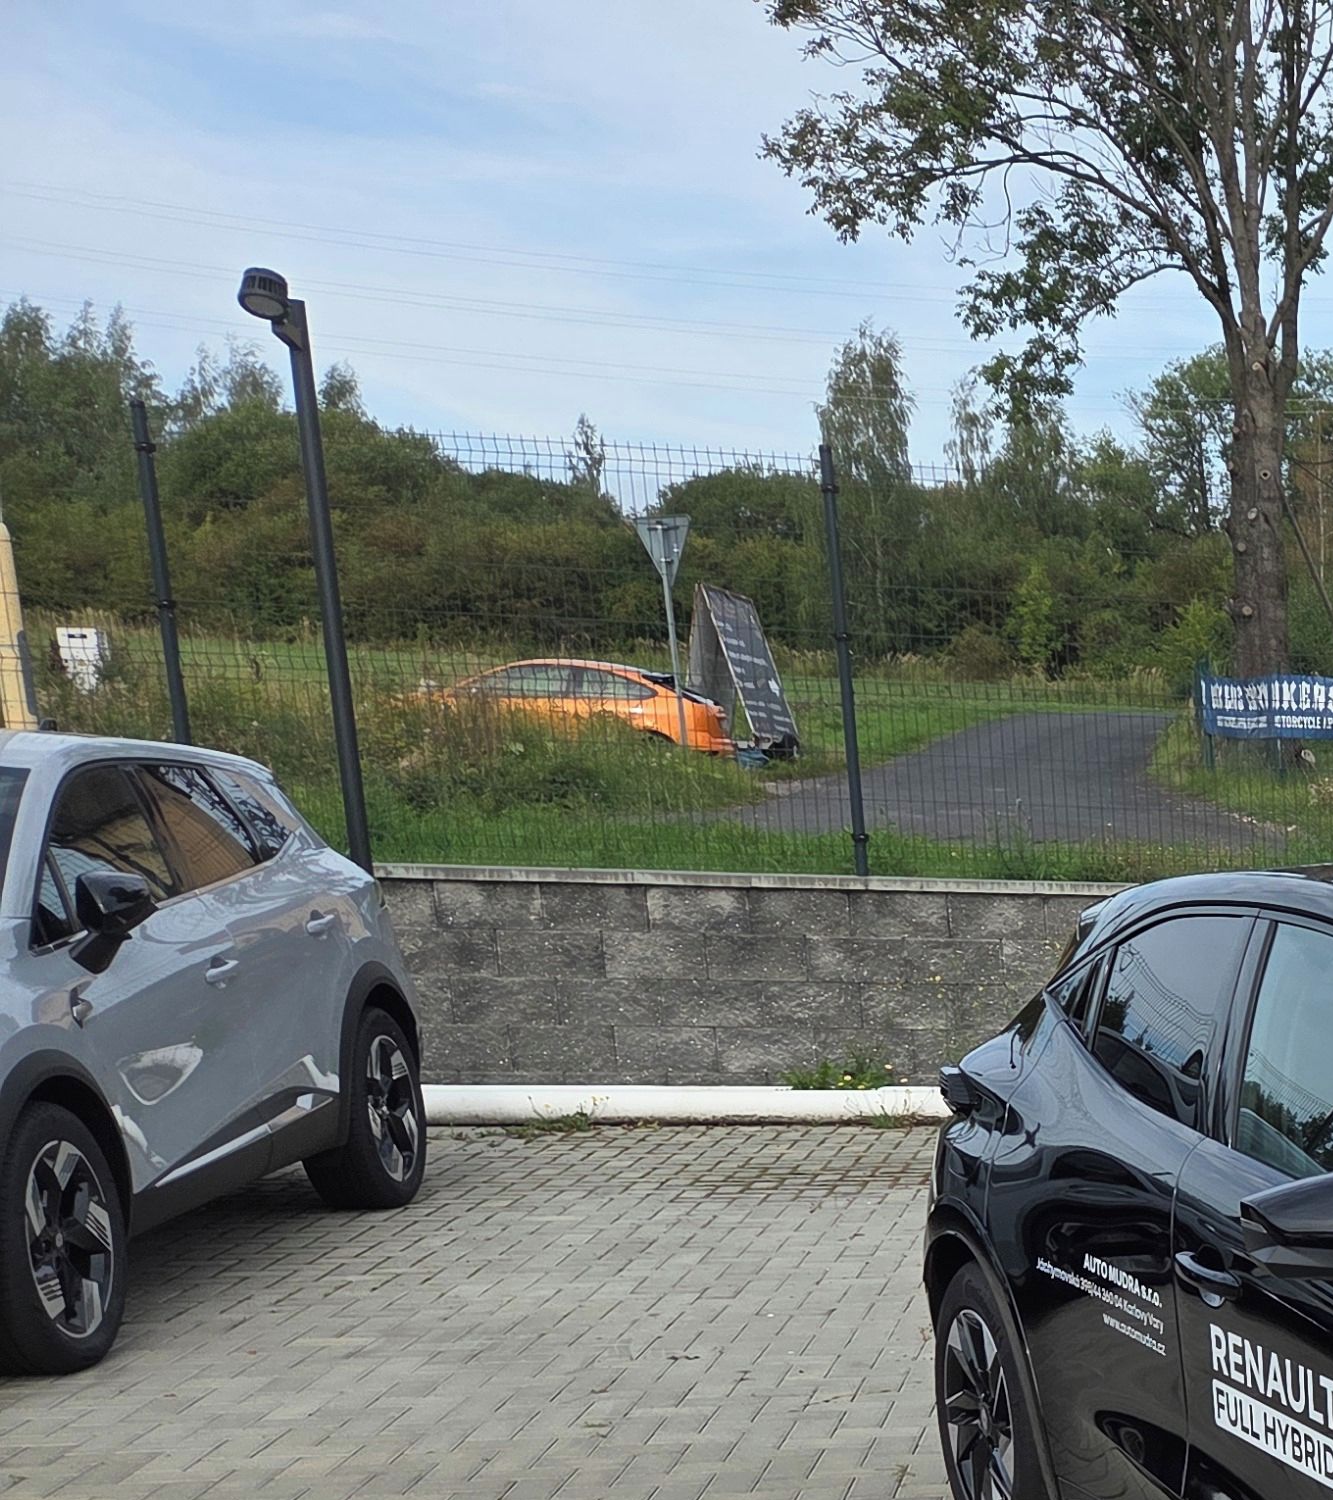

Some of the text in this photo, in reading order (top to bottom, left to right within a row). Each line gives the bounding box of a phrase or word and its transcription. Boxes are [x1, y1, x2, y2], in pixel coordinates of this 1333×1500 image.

[1083, 1253, 1108, 1279] AUTO
[1109, 1264, 1141, 1297] MUDRA
[1215, 1386, 1261, 1441] FULL
